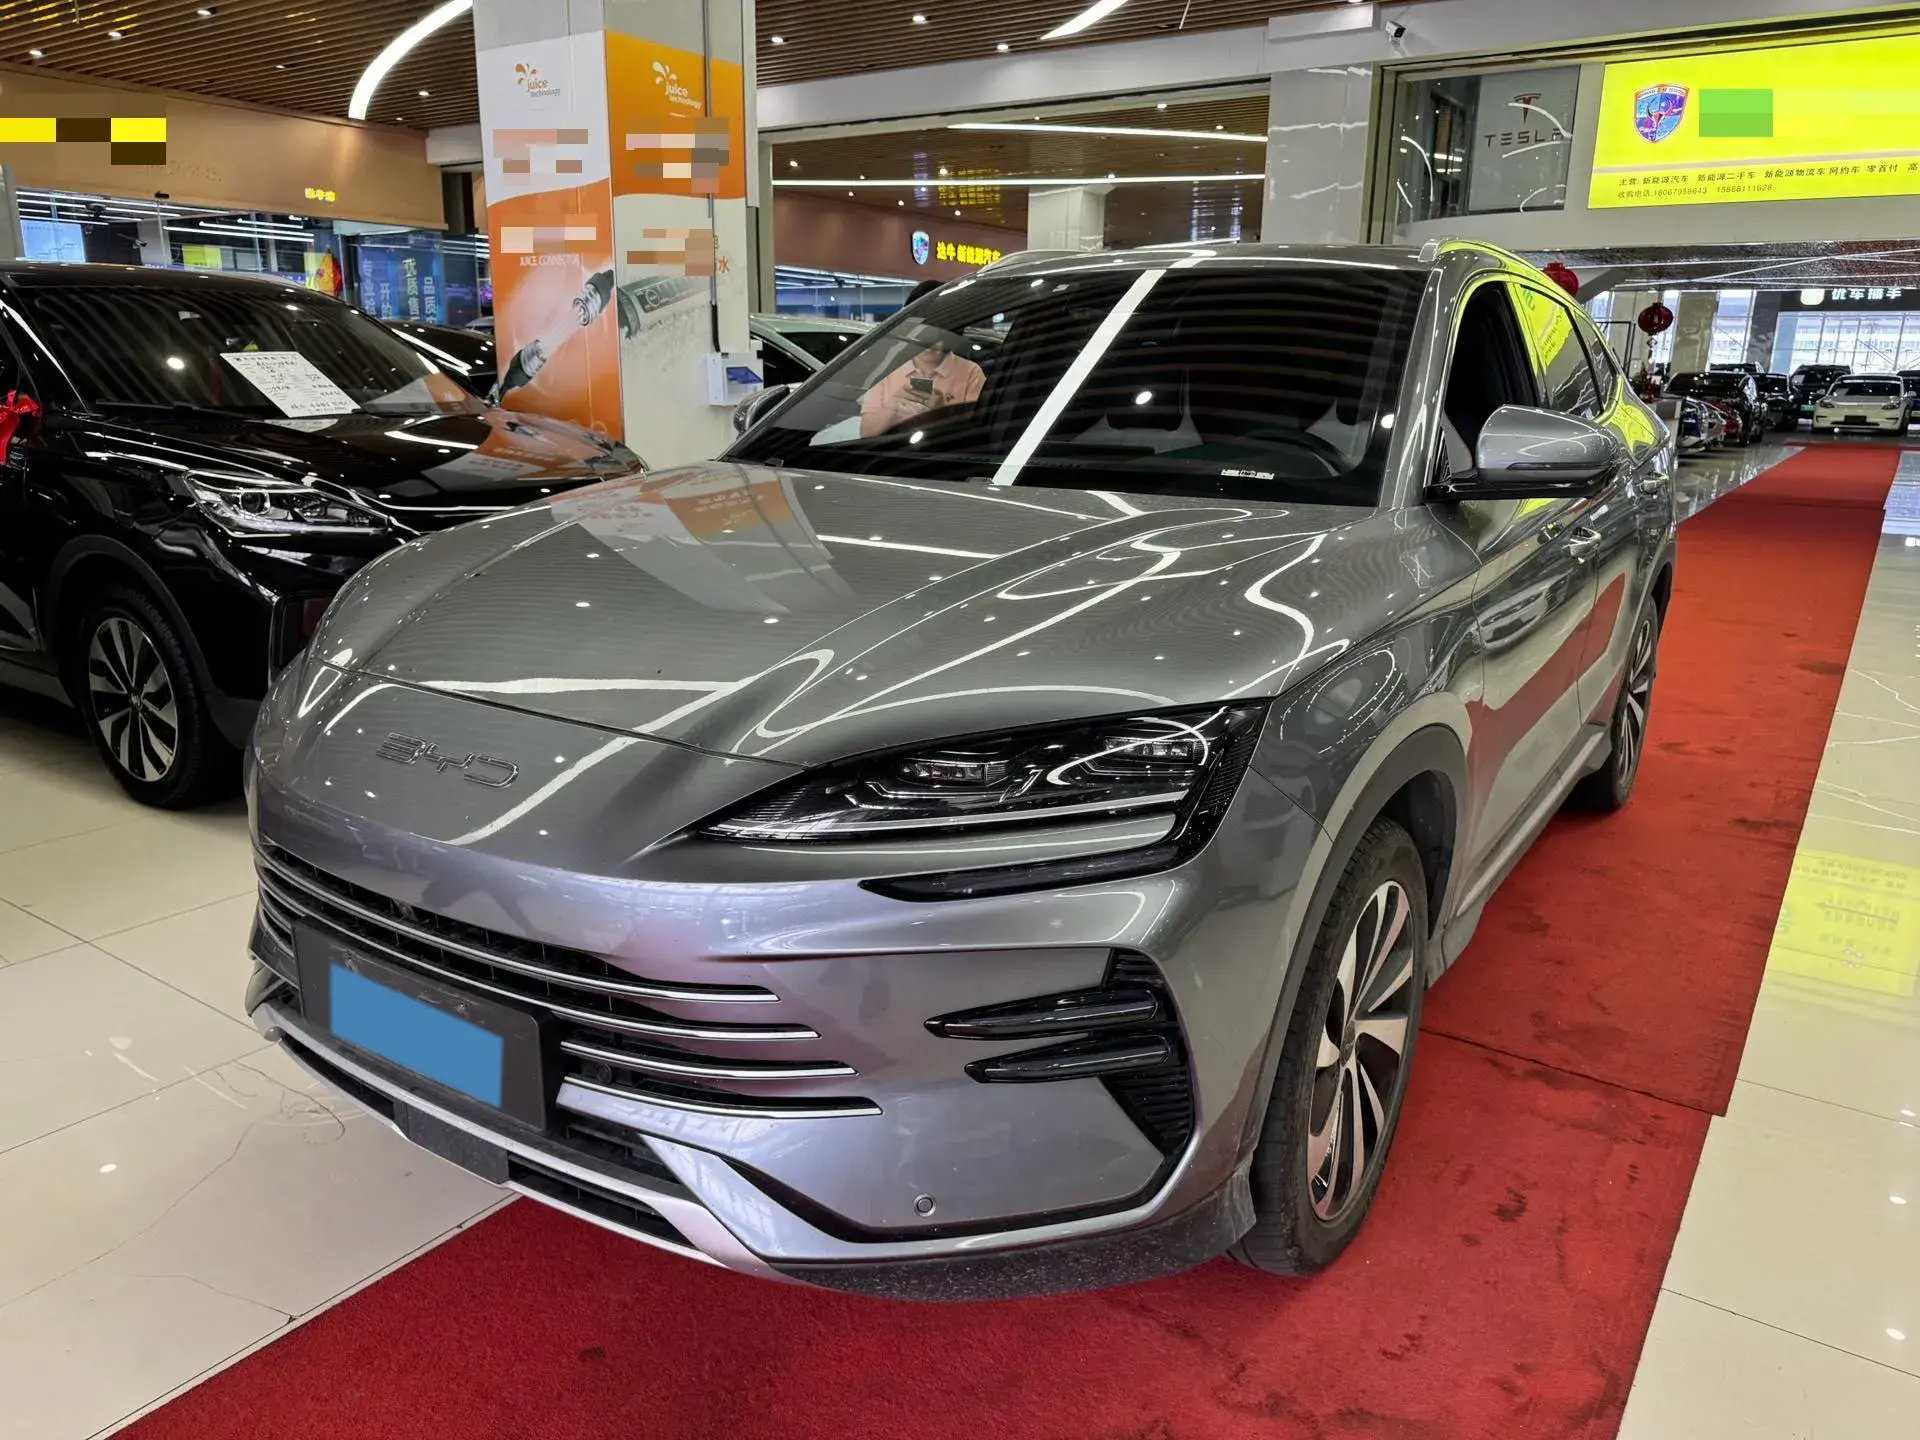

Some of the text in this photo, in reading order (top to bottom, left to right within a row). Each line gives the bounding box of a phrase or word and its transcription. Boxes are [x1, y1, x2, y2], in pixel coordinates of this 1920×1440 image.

[527, 79, 548, 92] juice
[530, 87, 561, 98] technology
[665, 84, 688, 97] juice
[669, 95, 702, 109] technology
[1484, 127, 1564, 147] TESLA
[1642, 175, 1689, 185] 新能源汽车
[1697, 171, 1756, 182] 新能源二手车
[1764, 167, 1826, 178] 新能源物流车
[1829, 165, 1860, 175] 网约车
[1867, 163, 1898, 173] 零首付
[375, 732, 520, 789] BYD
